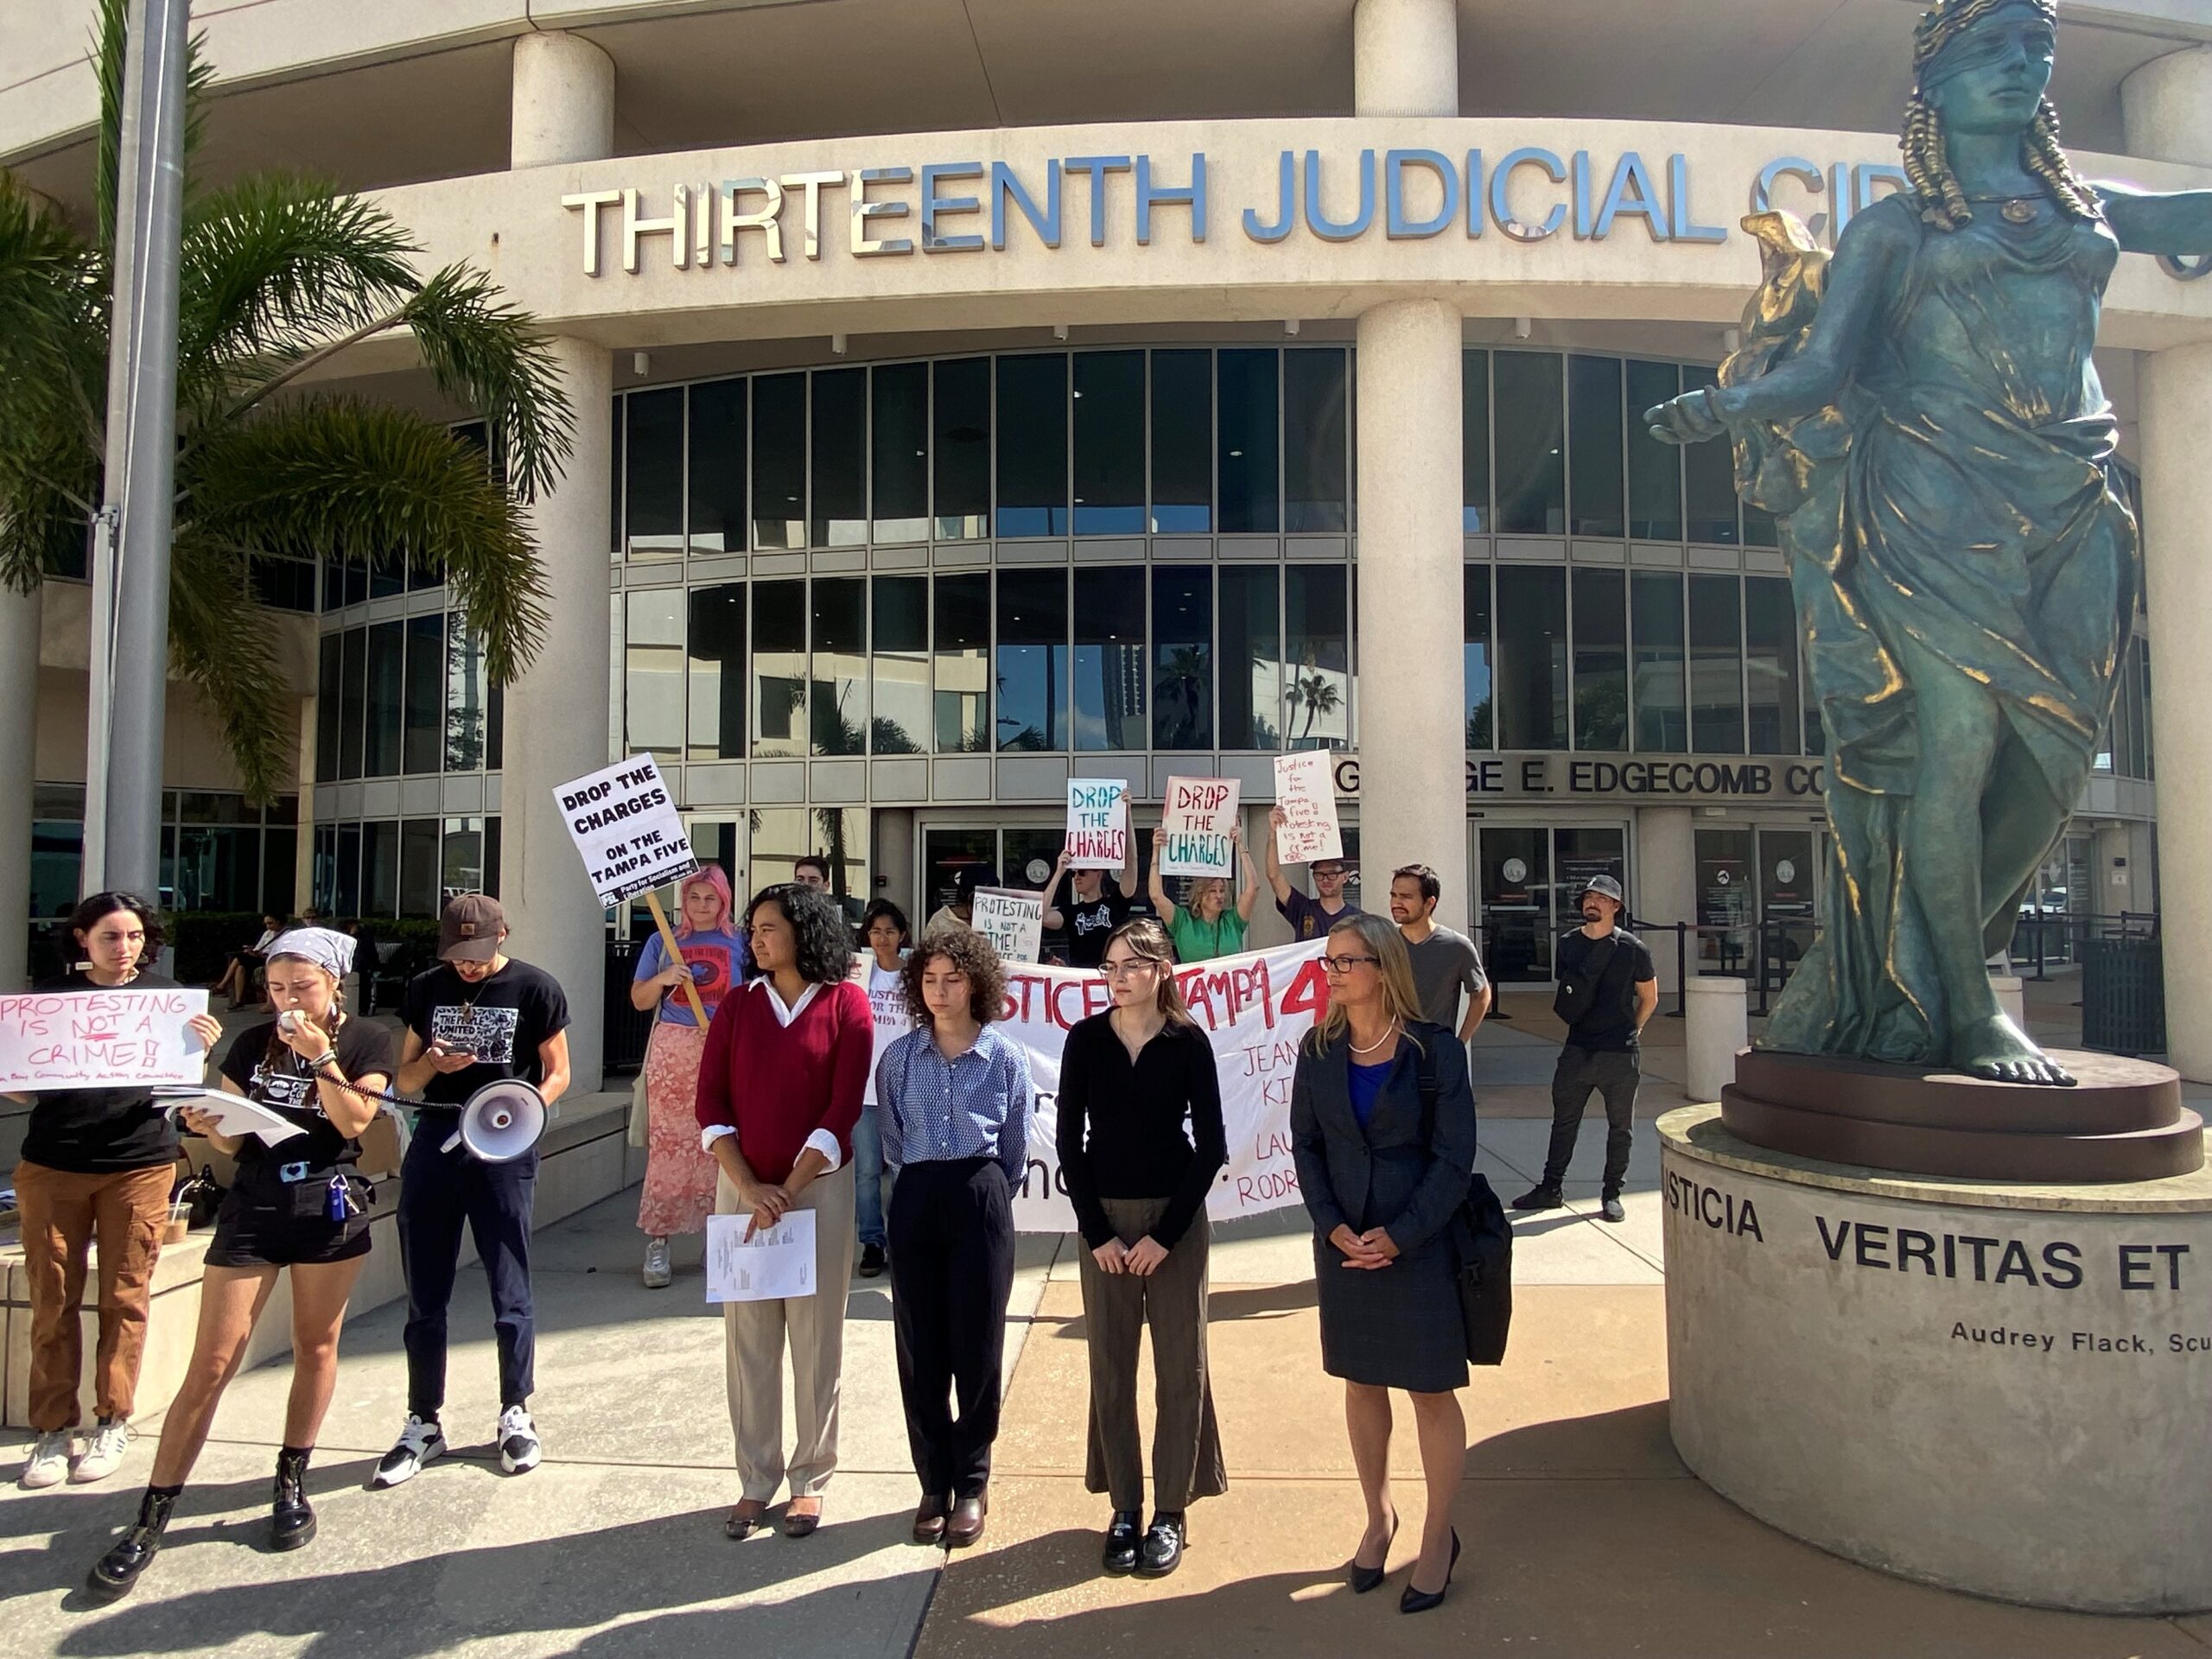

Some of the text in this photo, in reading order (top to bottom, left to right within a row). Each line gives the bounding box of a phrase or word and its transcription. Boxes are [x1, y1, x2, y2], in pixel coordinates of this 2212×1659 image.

[562, 151, 1206, 276] THIRTEENTH
[1243, 147, 1728, 245] JUDICIAL
[1275, 759, 1314, 773] Justice
[1522, 760, 1554, 792] E.
[1570, 761, 1771, 794] EDGECOMB
[563, 765, 657, 811] DROP THE
[1072, 785, 1122, 809] DROP
[1178, 785, 1229, 810] DROP
[1278, 796, 1309, 806] Tampa
[574, 788, 666, 835] CHARGES
[1078, 812, 1109, 828] THE
[1183, 815, 1215, 831] THE
[606, 830, 663, 860] ON THE
[1067, 830, 1125, 861] CHARGES
[1168, 833, 1228, 867] CHARGES
[591, 854, 652, 883] TAMPA
[653, 838, 689, 861] FIVE
[974, 896, 1043, 921] PROTESTING
[984, 918, 1027, 933] IS NOT A
[1, 994, 186, 1020] PROTESTING
[440, 1015, 456, 1024] THE
[21, 1014, 151, 1039] IS NOT A
[439, 1025, 475, 1034] UNITED
[29, 1039, 159, 1067] CRIME!
[1815, 1215, 2083, 1290] VERITAS
[2119, 1243, 2190, 1290] ET
[1951, 1321, 2055, 1353] Audrey
[2072, 1332, 2155, 1356] Flack,
